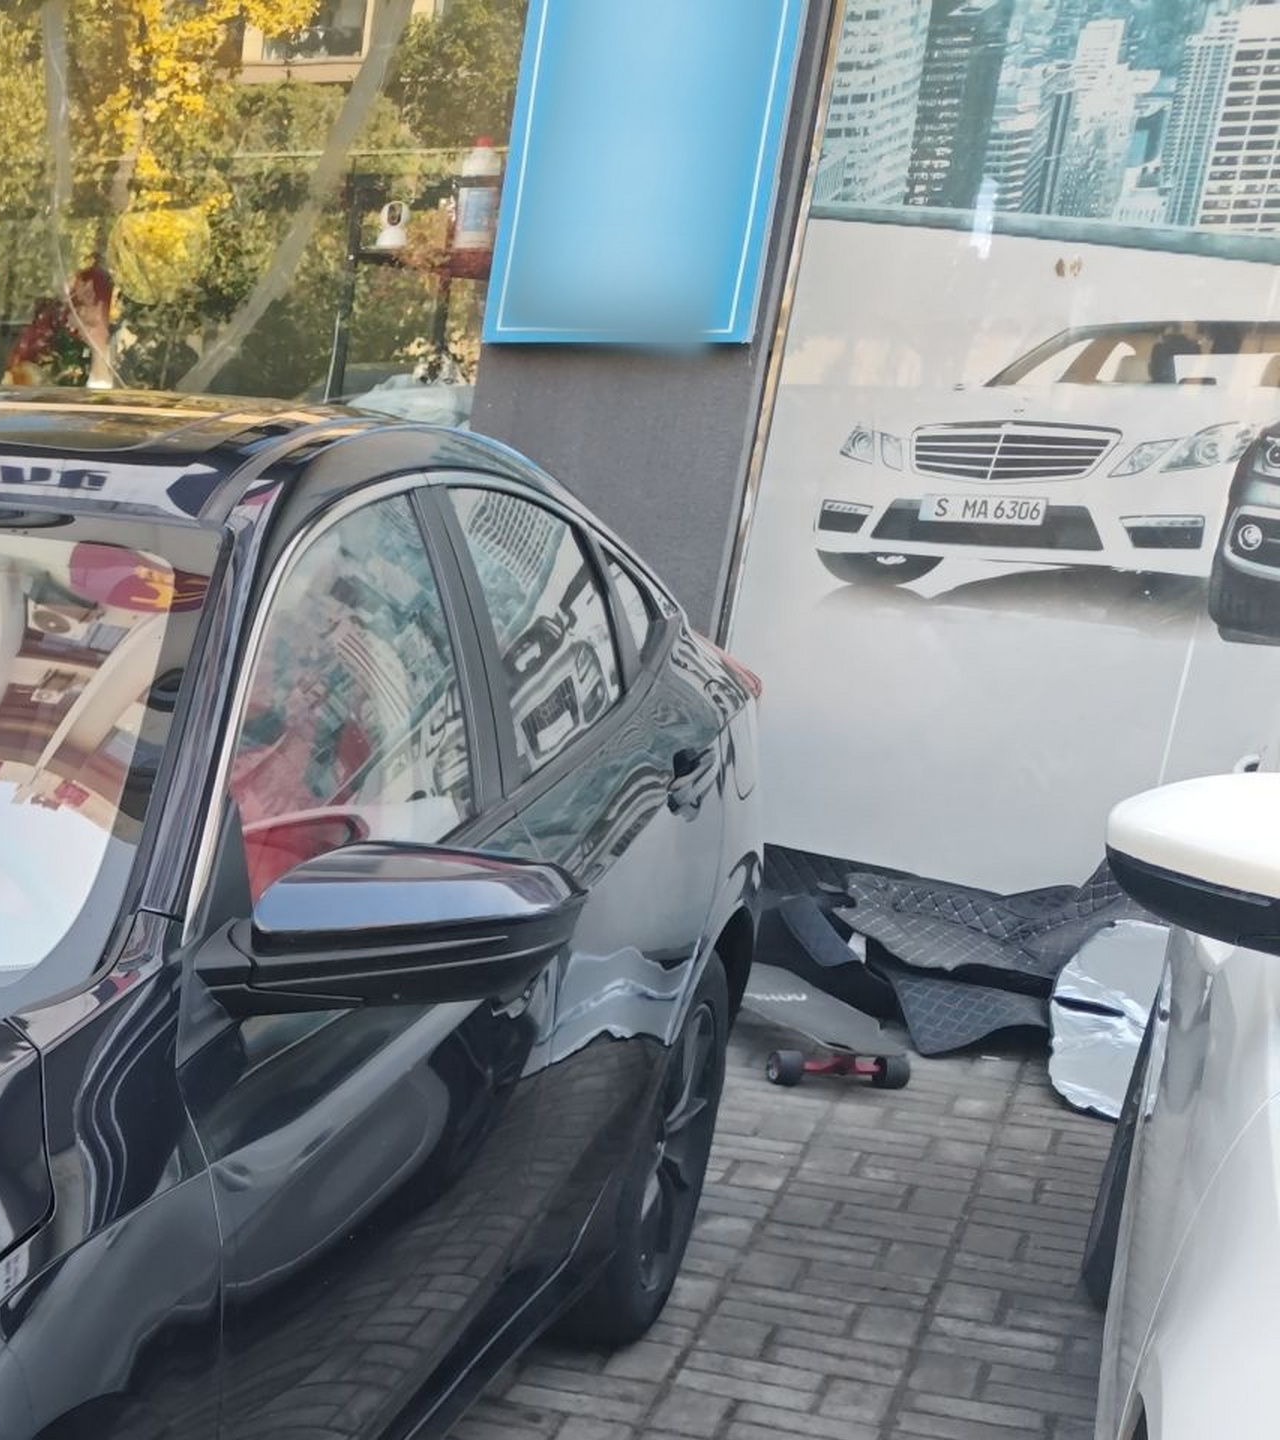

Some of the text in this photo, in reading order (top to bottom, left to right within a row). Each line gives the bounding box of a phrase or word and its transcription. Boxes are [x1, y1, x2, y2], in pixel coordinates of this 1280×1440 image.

[934, 497, 1041, 520] S MA 6306
